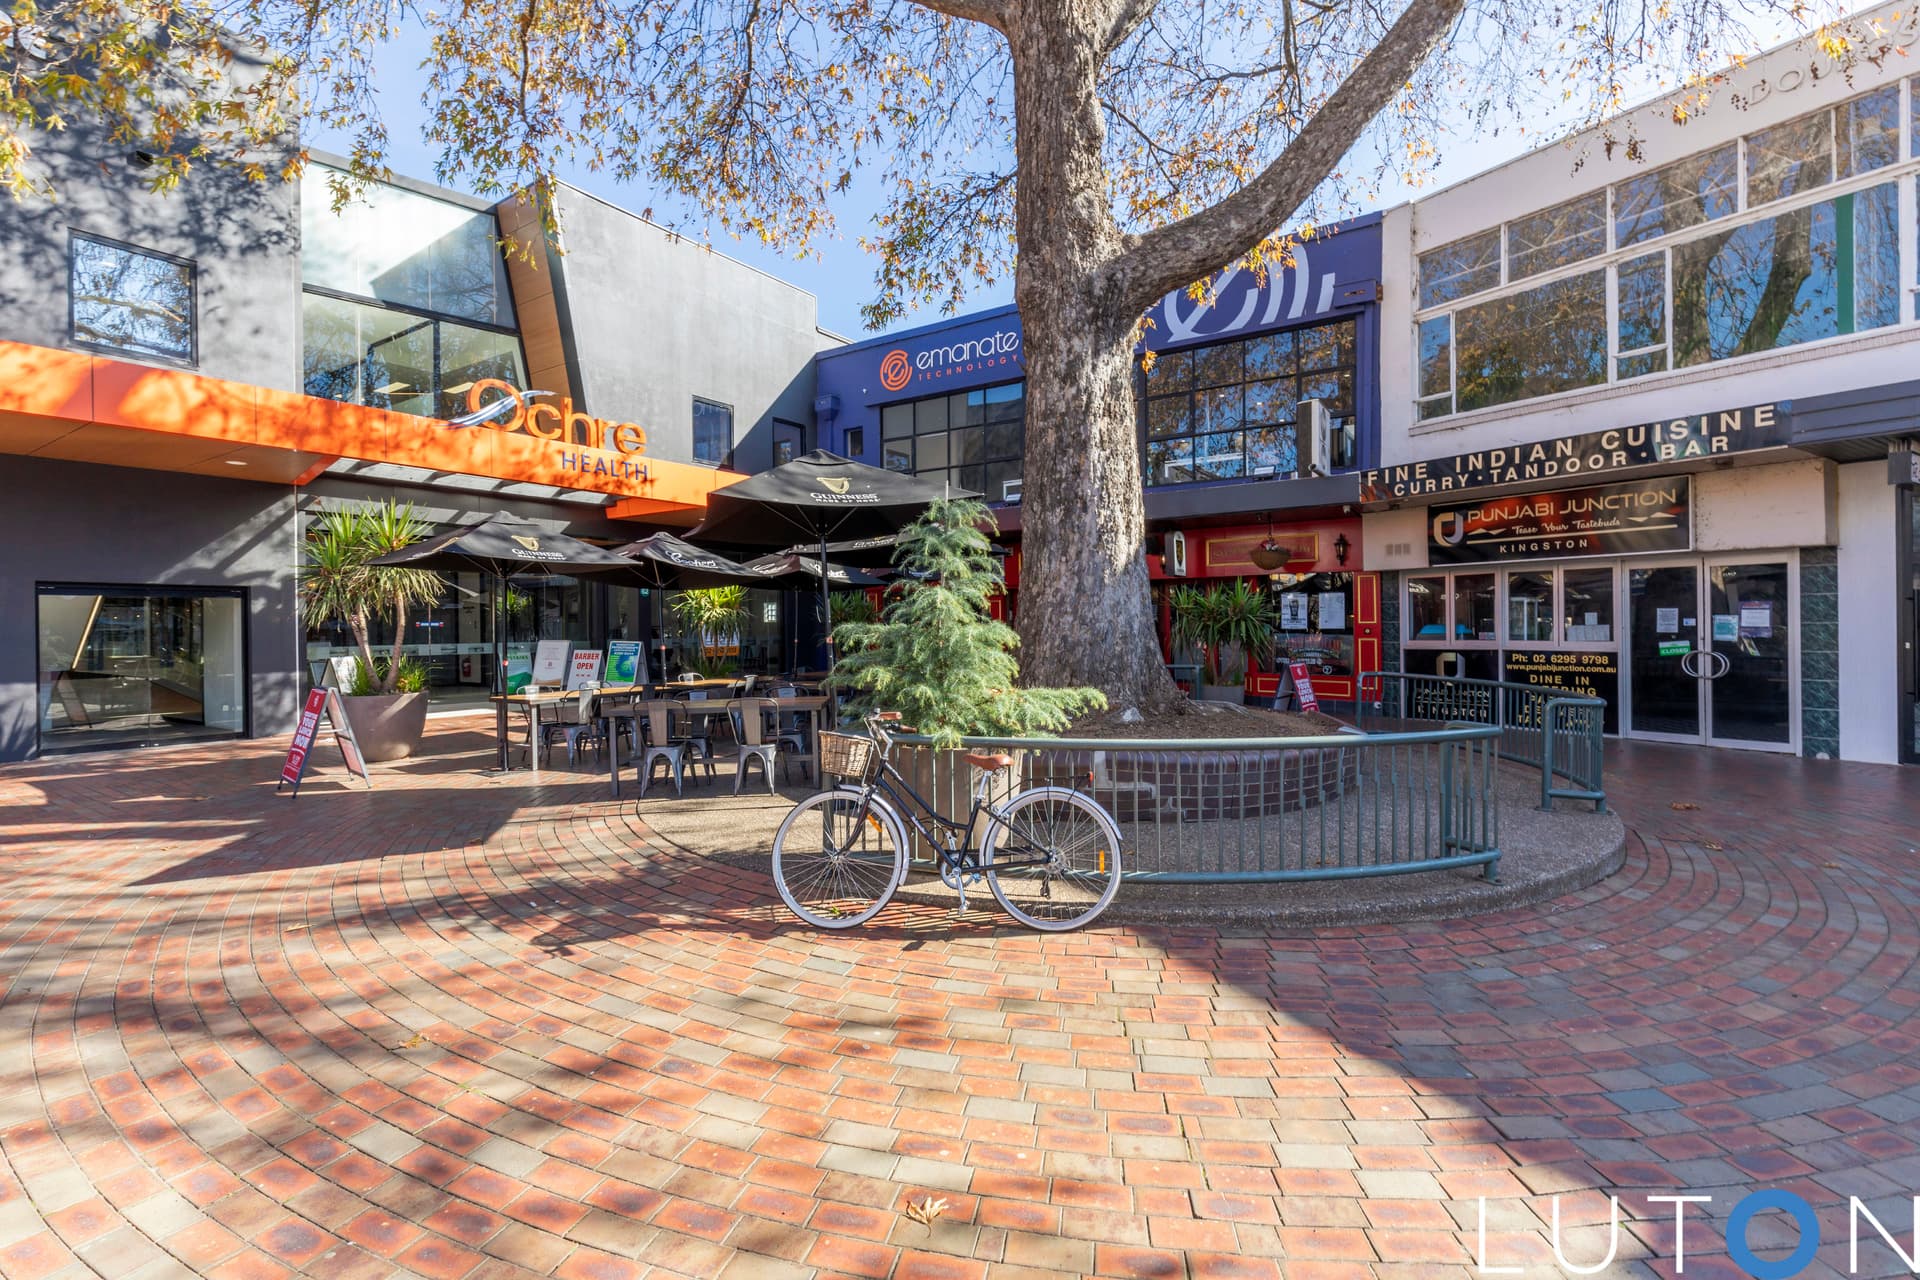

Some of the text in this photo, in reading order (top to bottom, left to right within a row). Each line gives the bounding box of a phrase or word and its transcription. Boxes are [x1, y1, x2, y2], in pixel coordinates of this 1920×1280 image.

[916, 331, 1020, 370] emanate
[918, 353, 1018, 380] TECHNOLOGY
[467, 378, 647, 456] Ochre
[1367, 404, 1776, 487] FINE INDIAN CUISINE
[561, 451, 649, 481] HEALTH
[1394, 436, 1729, 497] CURRY TANDOOR BAR
[810, 492, 878, 500] GUINNESS
[1467, 488, 1677, 523] PUNJABI JUNCTION
[1512, 516, 1620, 535] Tease Your Tastebuds
[1500, 539, 1588, 554] KINGSTON
[574, 652, 601, 660] BARBER
[1512, 653, 1609, 665] Ph: 02 6295 9798
[576, 662, 594, 670] OPEN
[1506, 664, 1617, 673] www.punjabijunction.com.au
[1530, 674, 1590, 685] DINE IN
